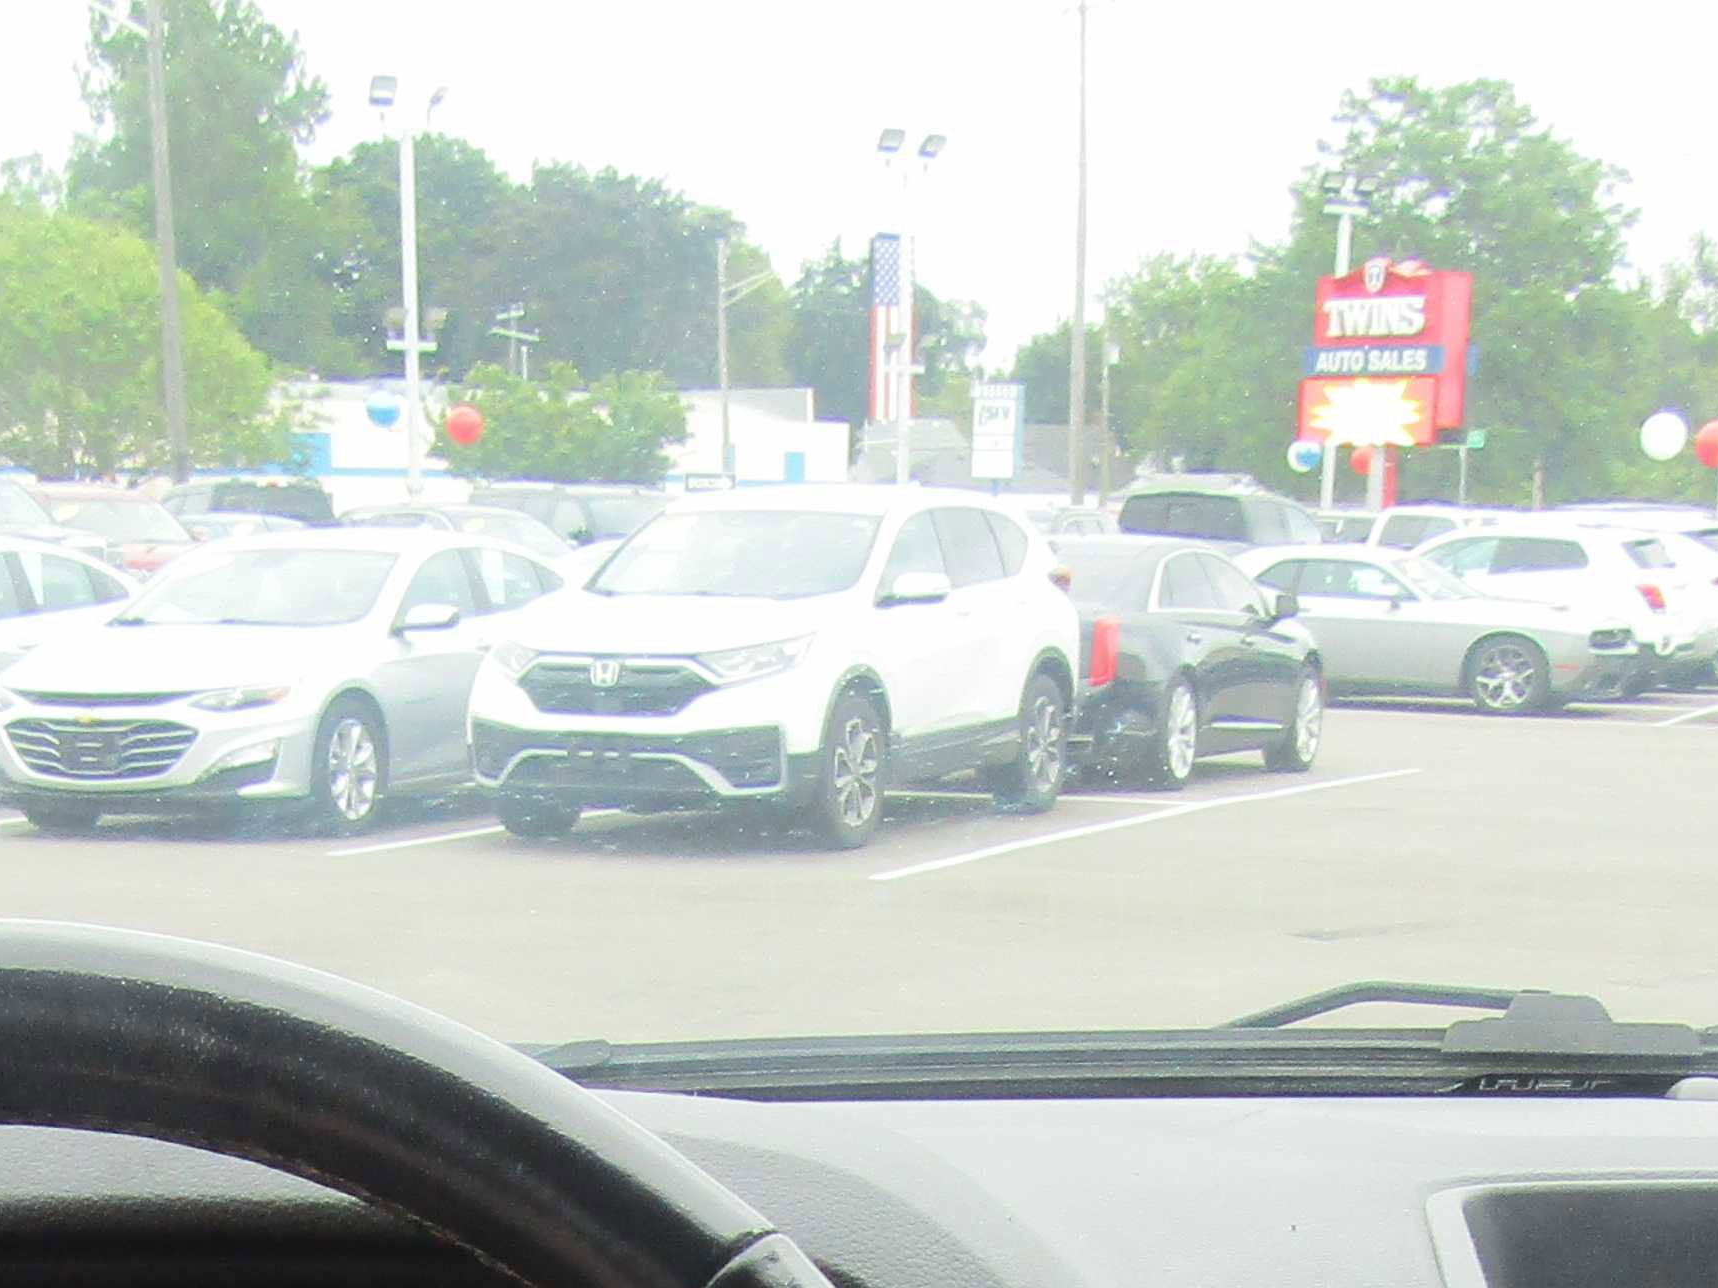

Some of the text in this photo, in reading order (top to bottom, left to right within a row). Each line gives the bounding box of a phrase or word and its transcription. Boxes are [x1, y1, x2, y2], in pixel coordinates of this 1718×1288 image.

[1323, 296, 1427, 337] TWINS
[1315, 350, 1428, 372] AUTO SALES
